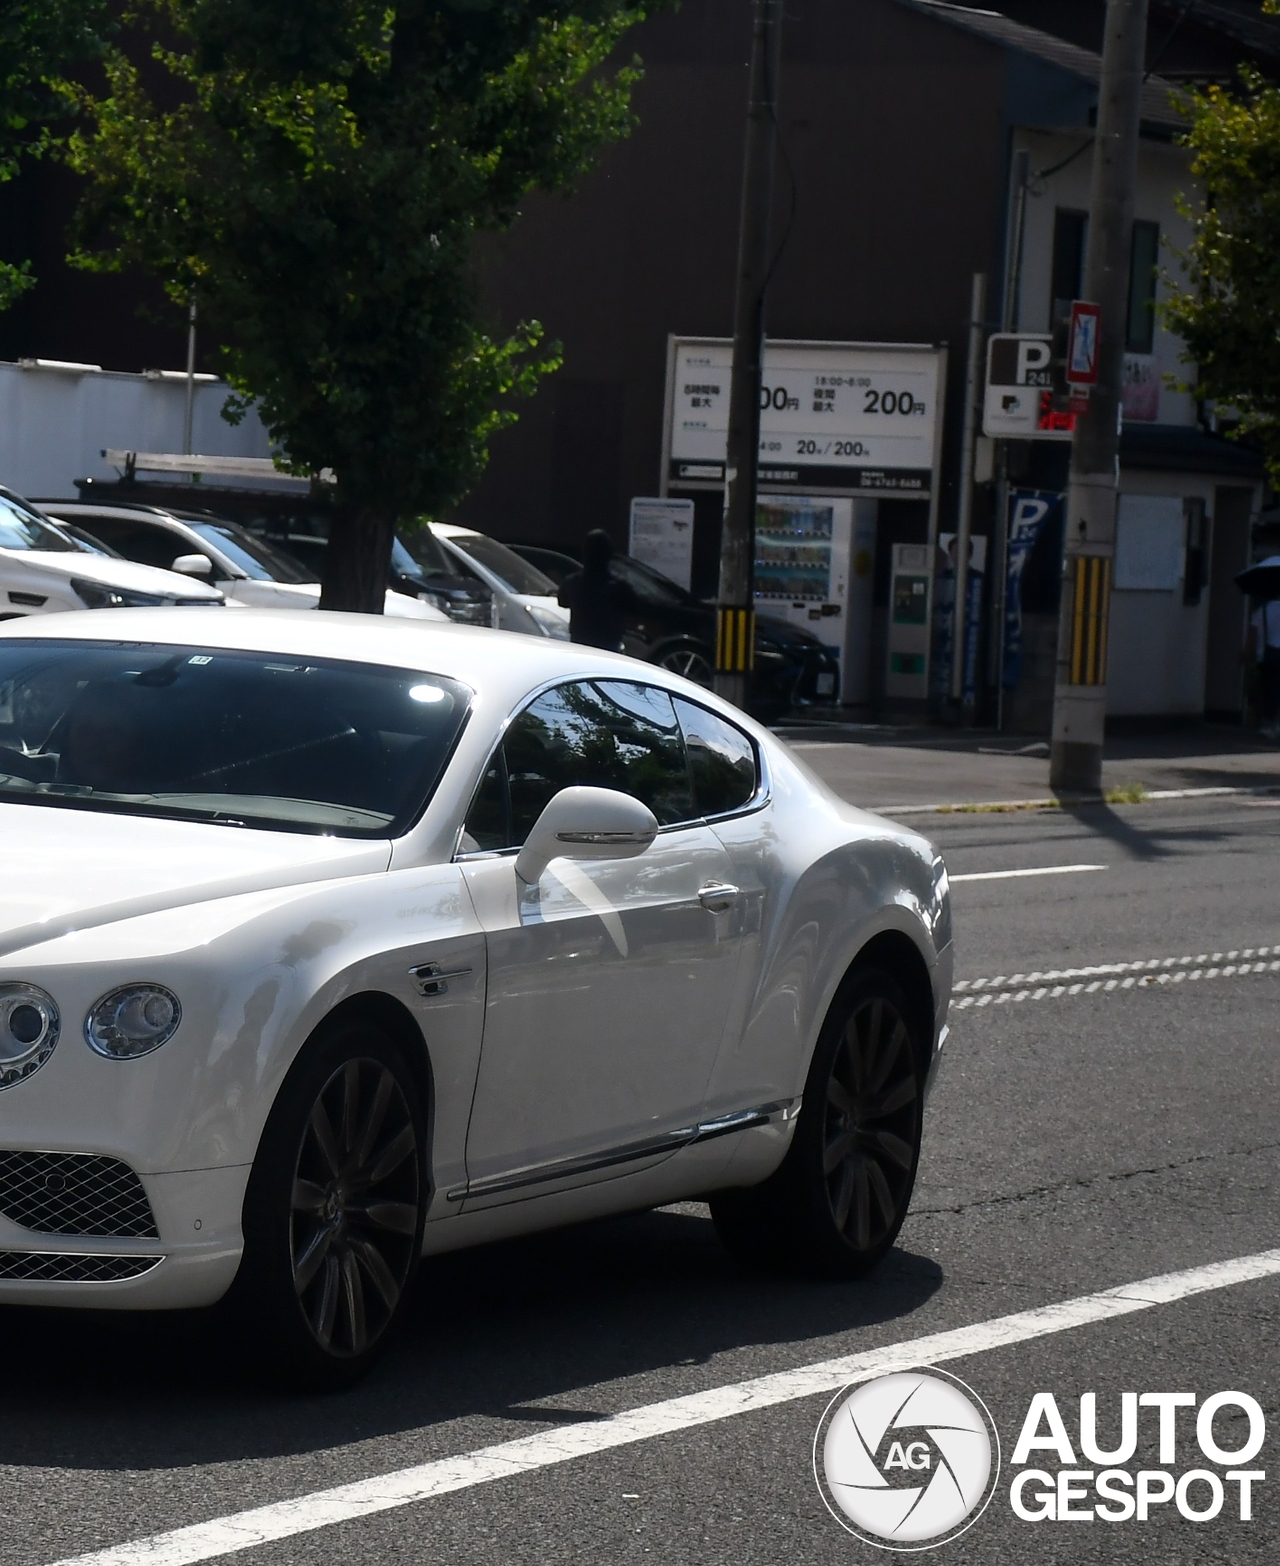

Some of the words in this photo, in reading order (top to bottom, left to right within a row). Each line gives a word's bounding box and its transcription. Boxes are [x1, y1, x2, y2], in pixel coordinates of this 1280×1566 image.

[1016, 341, 1051, 384] P
[863, 390, 926, 416] 200円
[1010, 498, 1049, 540] P
